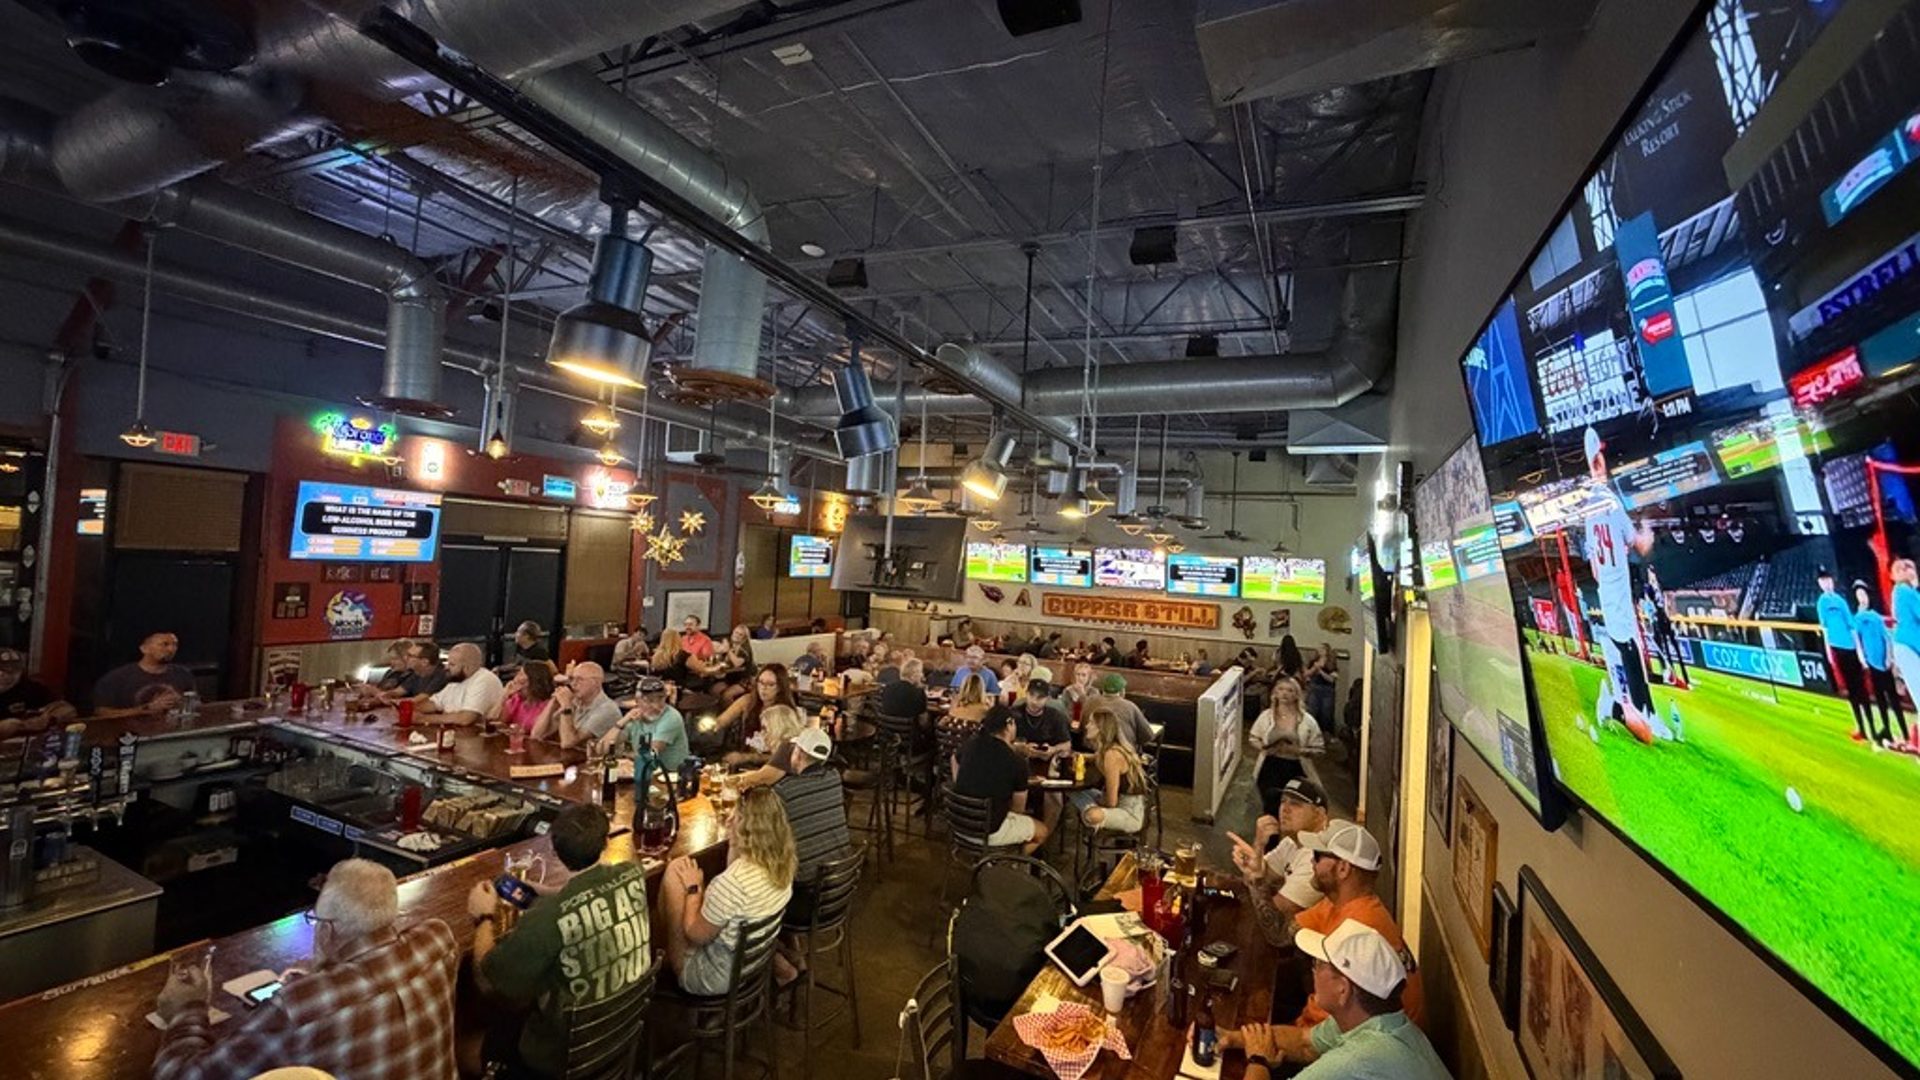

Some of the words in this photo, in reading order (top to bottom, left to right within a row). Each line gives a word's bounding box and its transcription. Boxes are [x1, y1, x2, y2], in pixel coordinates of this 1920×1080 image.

[162, 433, 193, 455] EXIT
[1593, 523, 1616, 568] 34
[1048, 597, 1139, 619] COPPER
[1145, 603, 1214, 625] STILL
[1711, 646, 1743, 670] COX
[1750, 651, 1788, 678] COX
[1800, 660, 1827, 681] 374
[557, 897, 614, 946] BIG
[614, 877, 646, 921] AS
[560, 888, 595, 912] POST
[560, 912, 650, 978] STADIU
